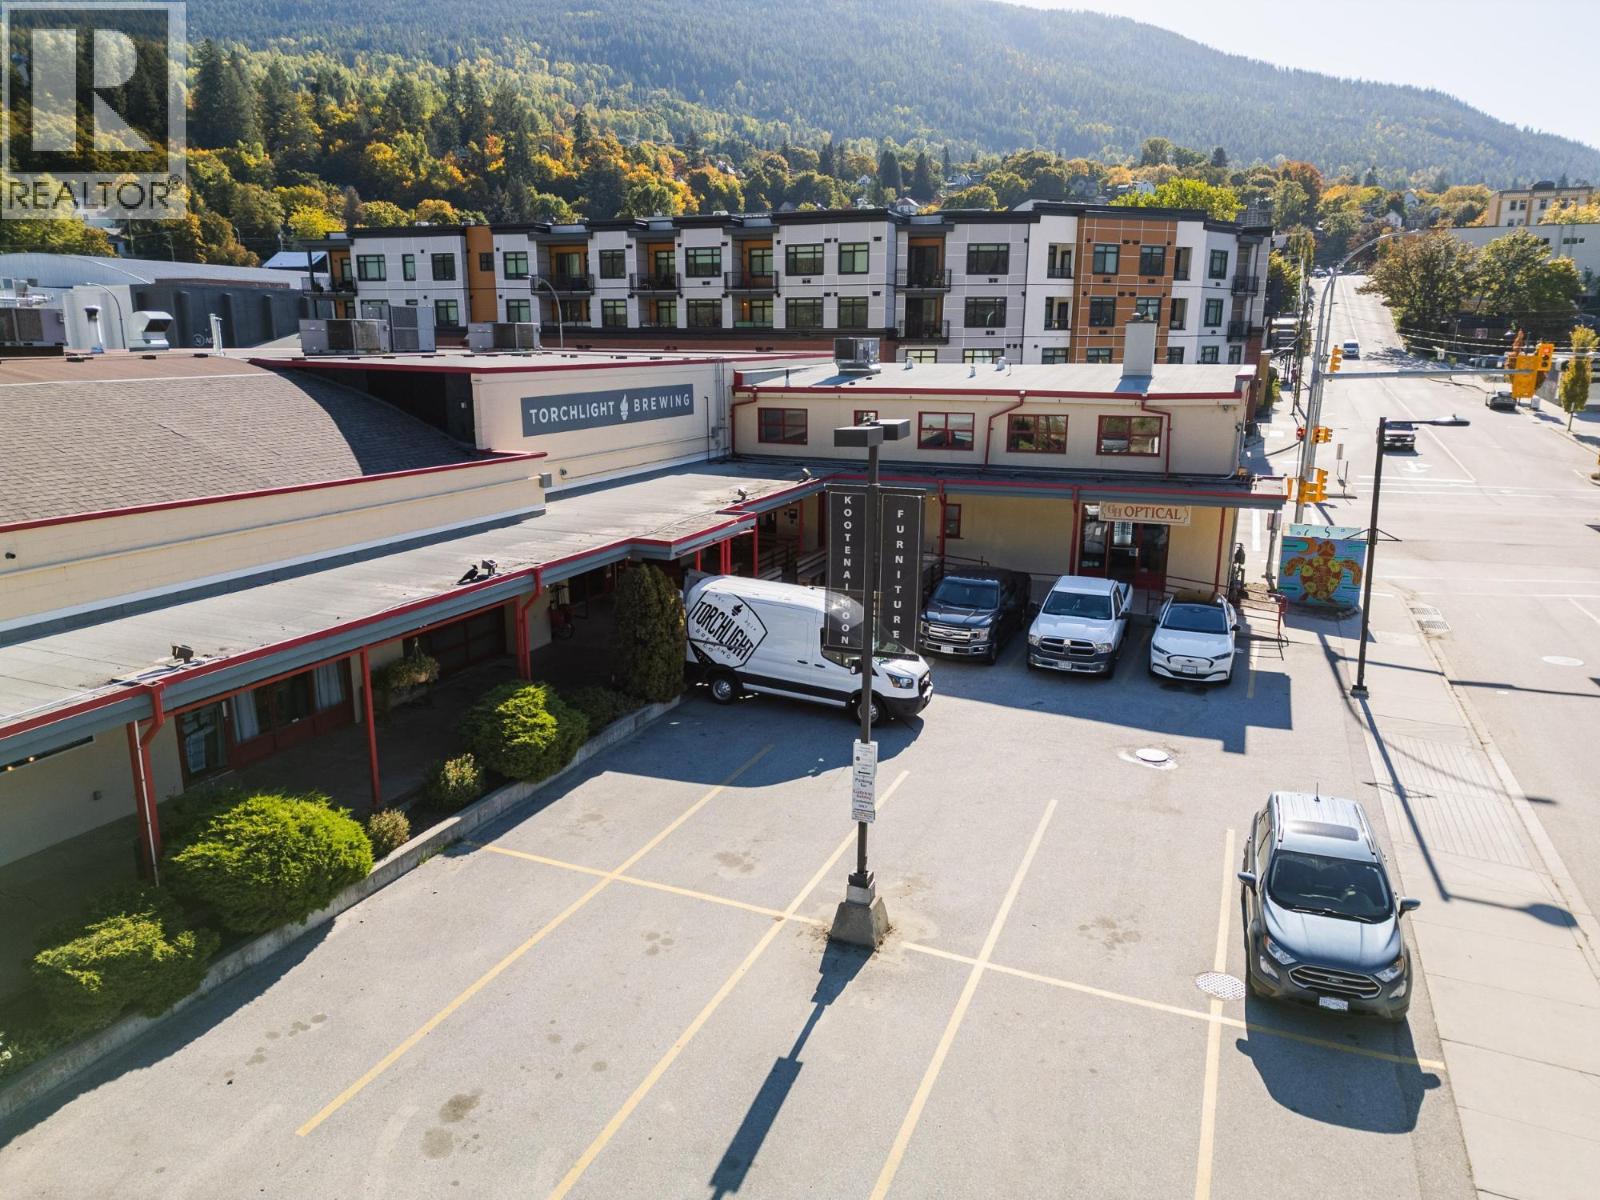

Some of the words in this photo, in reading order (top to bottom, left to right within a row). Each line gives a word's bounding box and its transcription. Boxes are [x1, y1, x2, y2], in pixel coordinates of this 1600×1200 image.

[529, 401, 615, 425] TORCHLIGHT
[633, 393, 690, 412] BREWING
[1124, 505, 1181, 520] OPTICAL
[843, 496, 852, 591] KOOTENAI
[892, 509, 905, 639] FURNITURE
[691, 600, 754, 661] TORCHLIGHT
